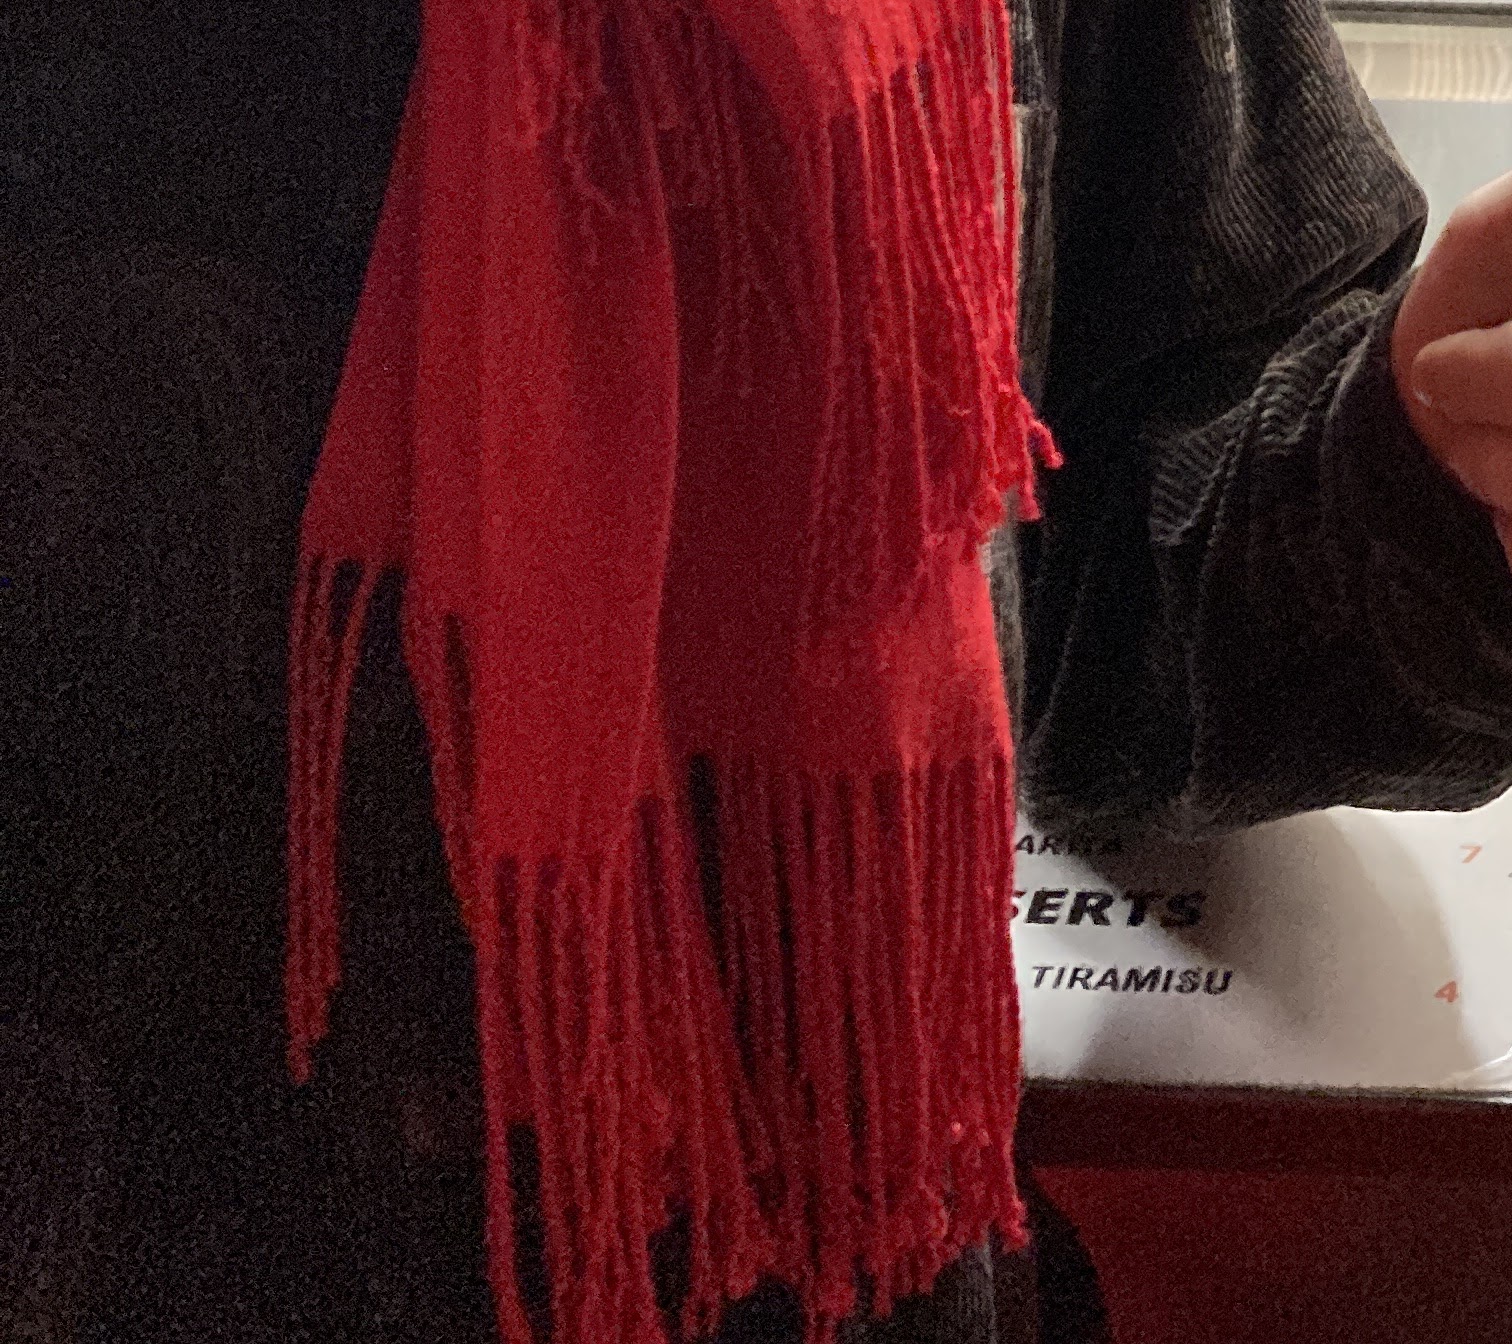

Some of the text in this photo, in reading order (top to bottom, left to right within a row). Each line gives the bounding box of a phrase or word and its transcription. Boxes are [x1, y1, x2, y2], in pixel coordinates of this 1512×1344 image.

[1012, 887, 1207, 928] ERTS
[1032, 965, 1235, 996] TIRAMISU
[1434, 979, 1458, 1003] 4
